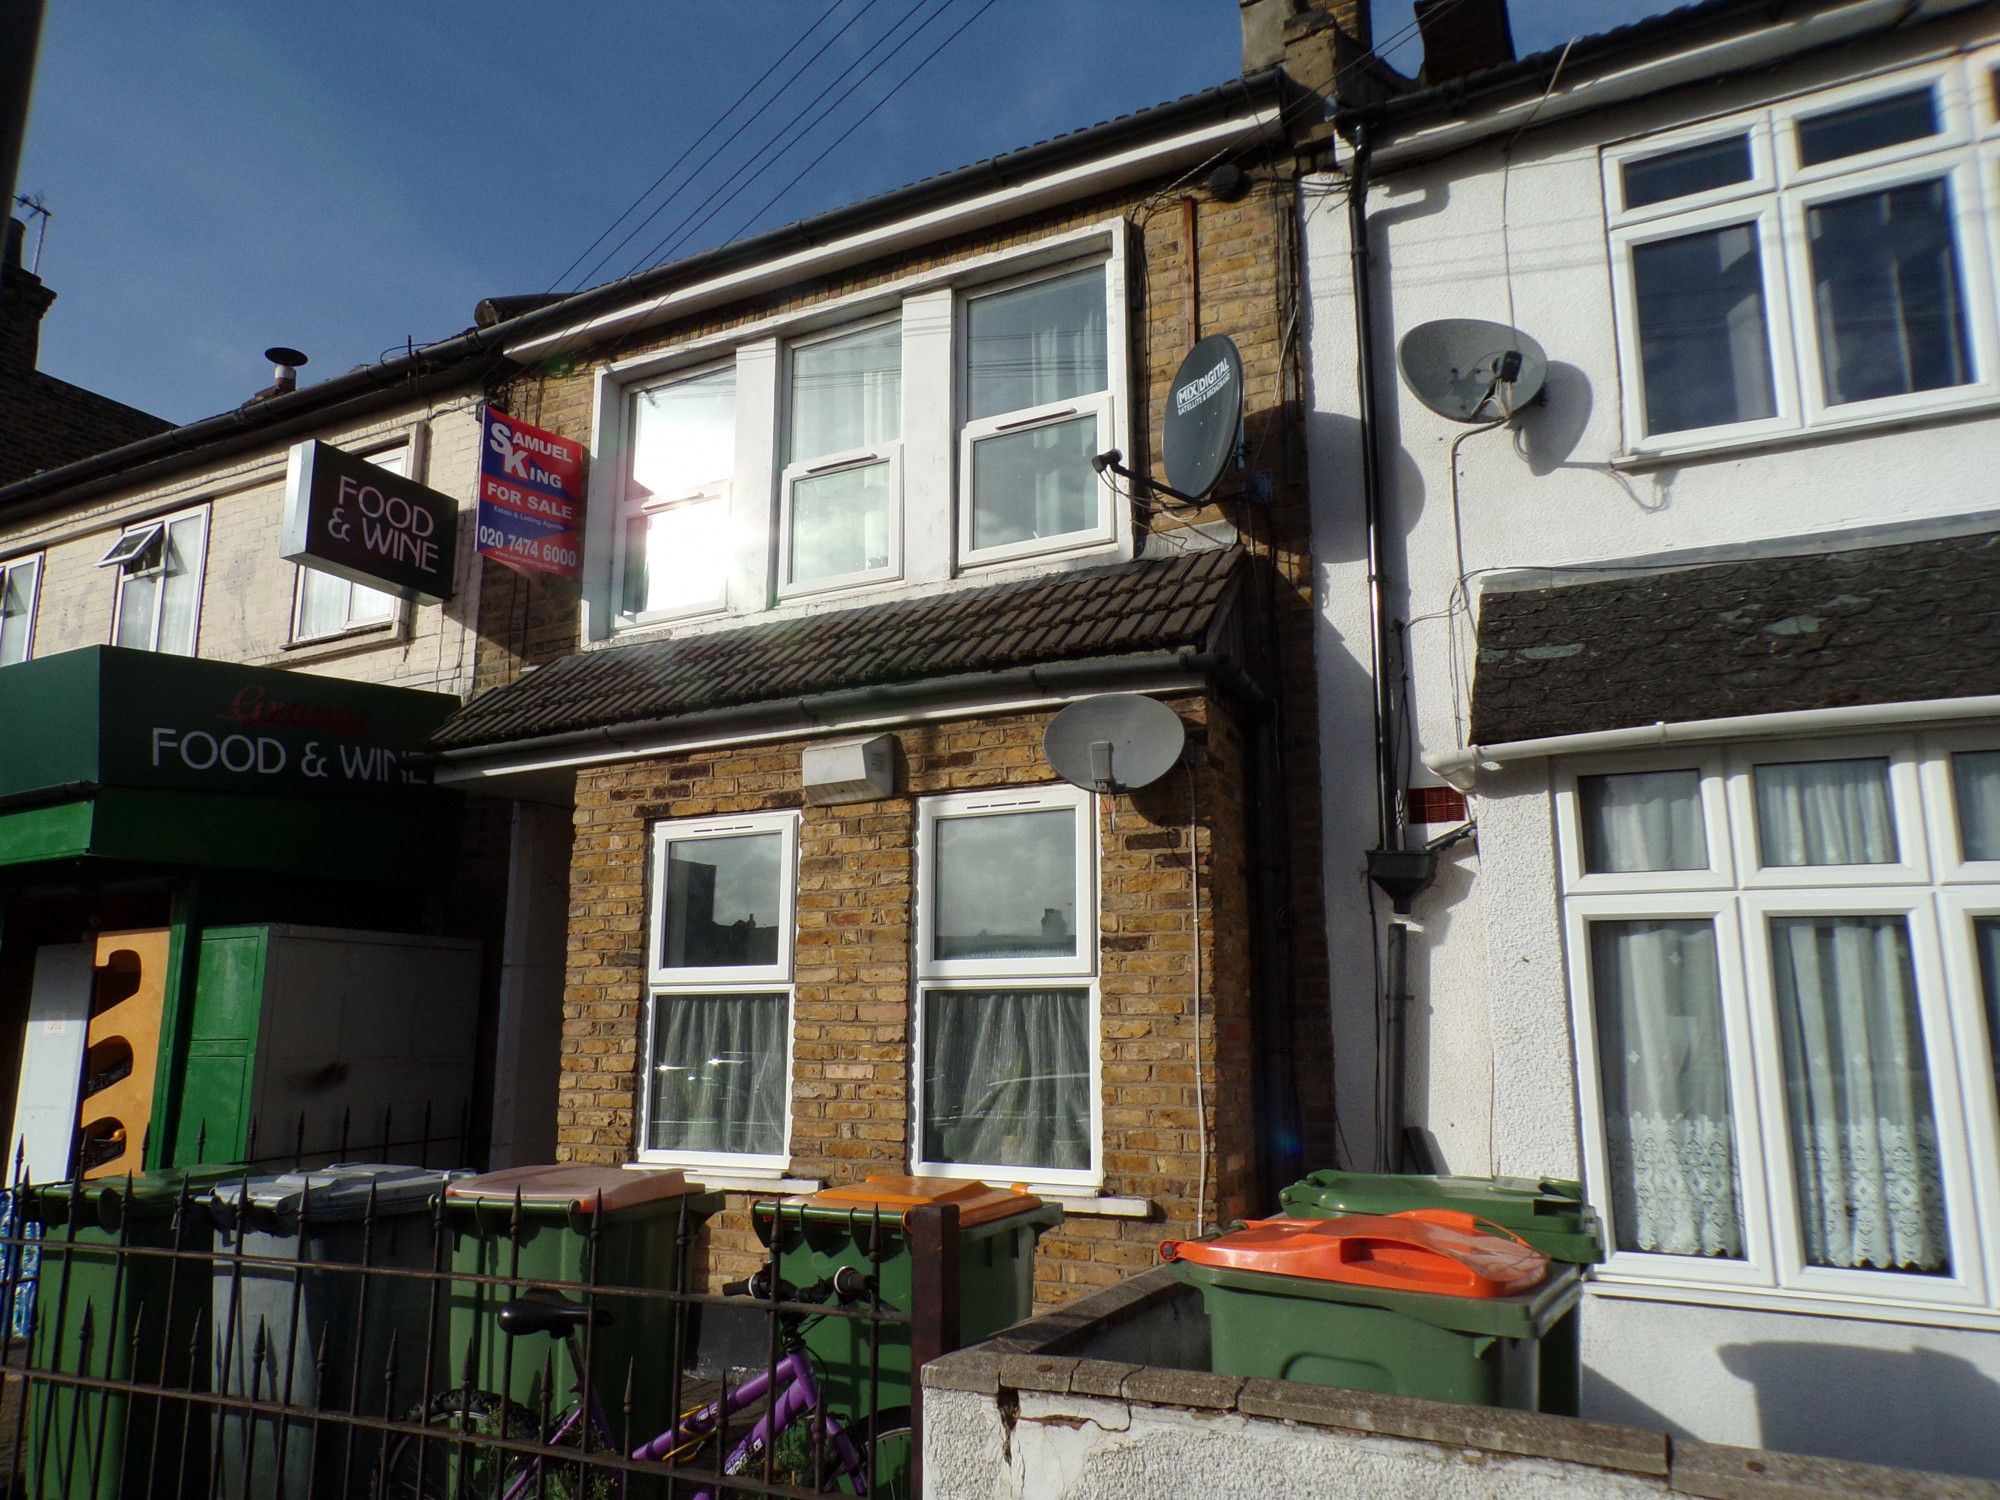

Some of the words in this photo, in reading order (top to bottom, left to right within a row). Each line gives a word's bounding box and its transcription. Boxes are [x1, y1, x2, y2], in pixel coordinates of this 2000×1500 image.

[1178, 382, 1198, 404] MIX
[1199, 357, 1230, 392] DIGITAL
[1178, 398, 1203, 416] SATELLITE
[1206, 372, 1231, 398] BROADBAND
[490, 422, 573, 463] SAMUEL
[503, 450, 563, 489] KING
[339, 475, 434, 538] FOOD
[487, 481, 522, 505] FOR
[527, 495, 573, 520] SALE
[493, 505, 512, 517] Estate
[520, 513, 543, 526] Letting
[328, 507, 351, 543] &
[362, 517, 439, 574] WINE
[480, 525, 504, 548] 020
[508, 534, 539, 559] 7474
[543, 544, 576, 567] 6000
[152, 727, 287, 774] FOOD
[301, 741, 328, 778] &
